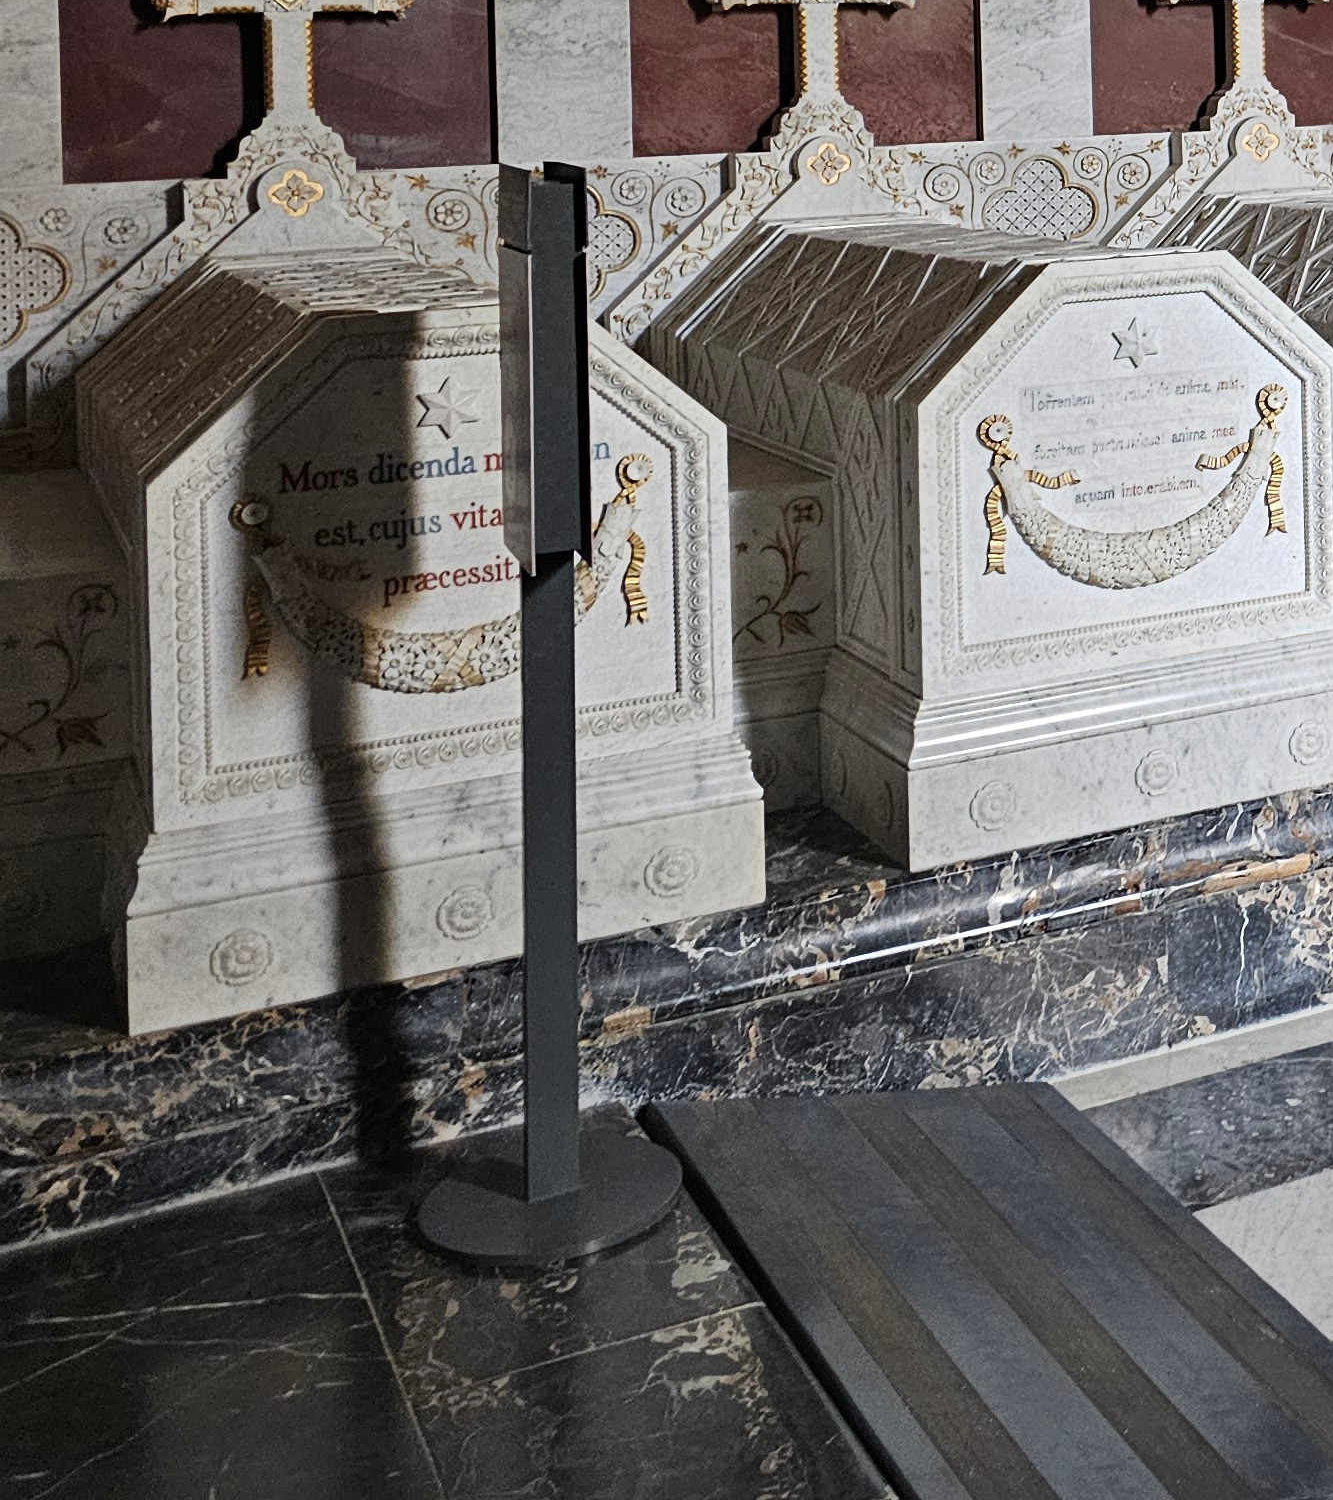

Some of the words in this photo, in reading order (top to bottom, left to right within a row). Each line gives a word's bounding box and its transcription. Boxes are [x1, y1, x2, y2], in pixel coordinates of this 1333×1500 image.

[278, 460, 359, 496] Mors
[368, 446, 478, 484] dicenda
[368, 510, 443, 549] cujus
[449, 501, 502, 532] vita
